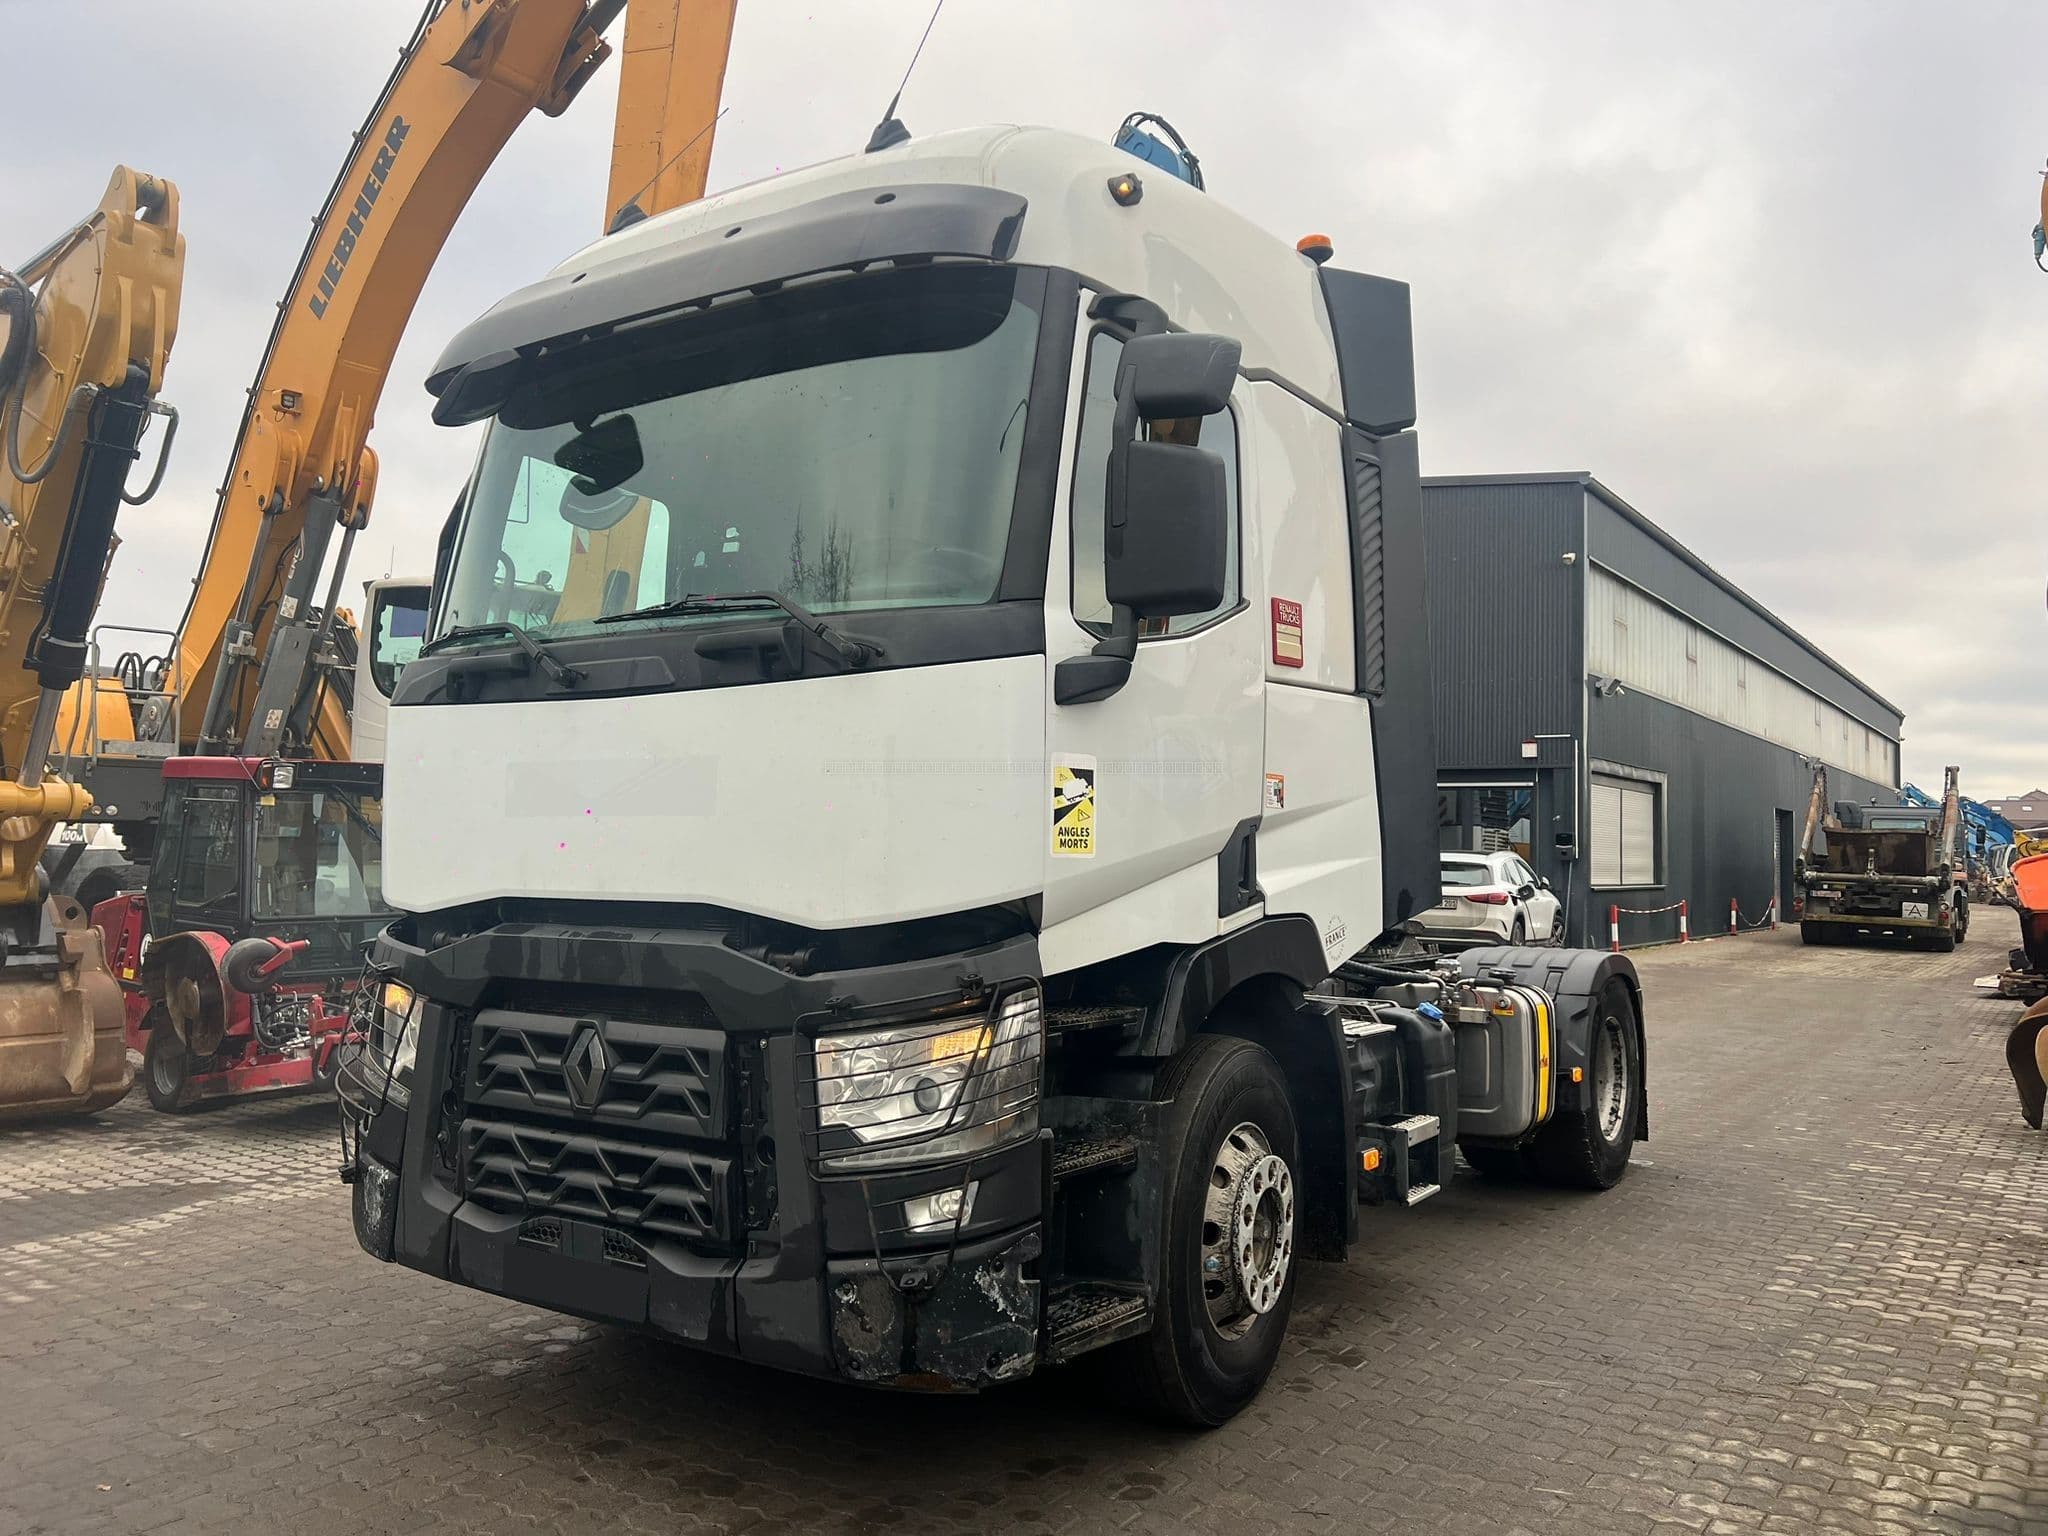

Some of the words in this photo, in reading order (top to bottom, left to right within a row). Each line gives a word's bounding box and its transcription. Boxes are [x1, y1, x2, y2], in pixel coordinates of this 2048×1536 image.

[308, 115, 411, 321] LIEBHERR
[1058, 826, 1090, 837] ANGLES
[1060, 838, 1088, 849] MORTS
[1908, 904, 1922, 917] A
[1325, 927, 1346, 947] FRANCE
